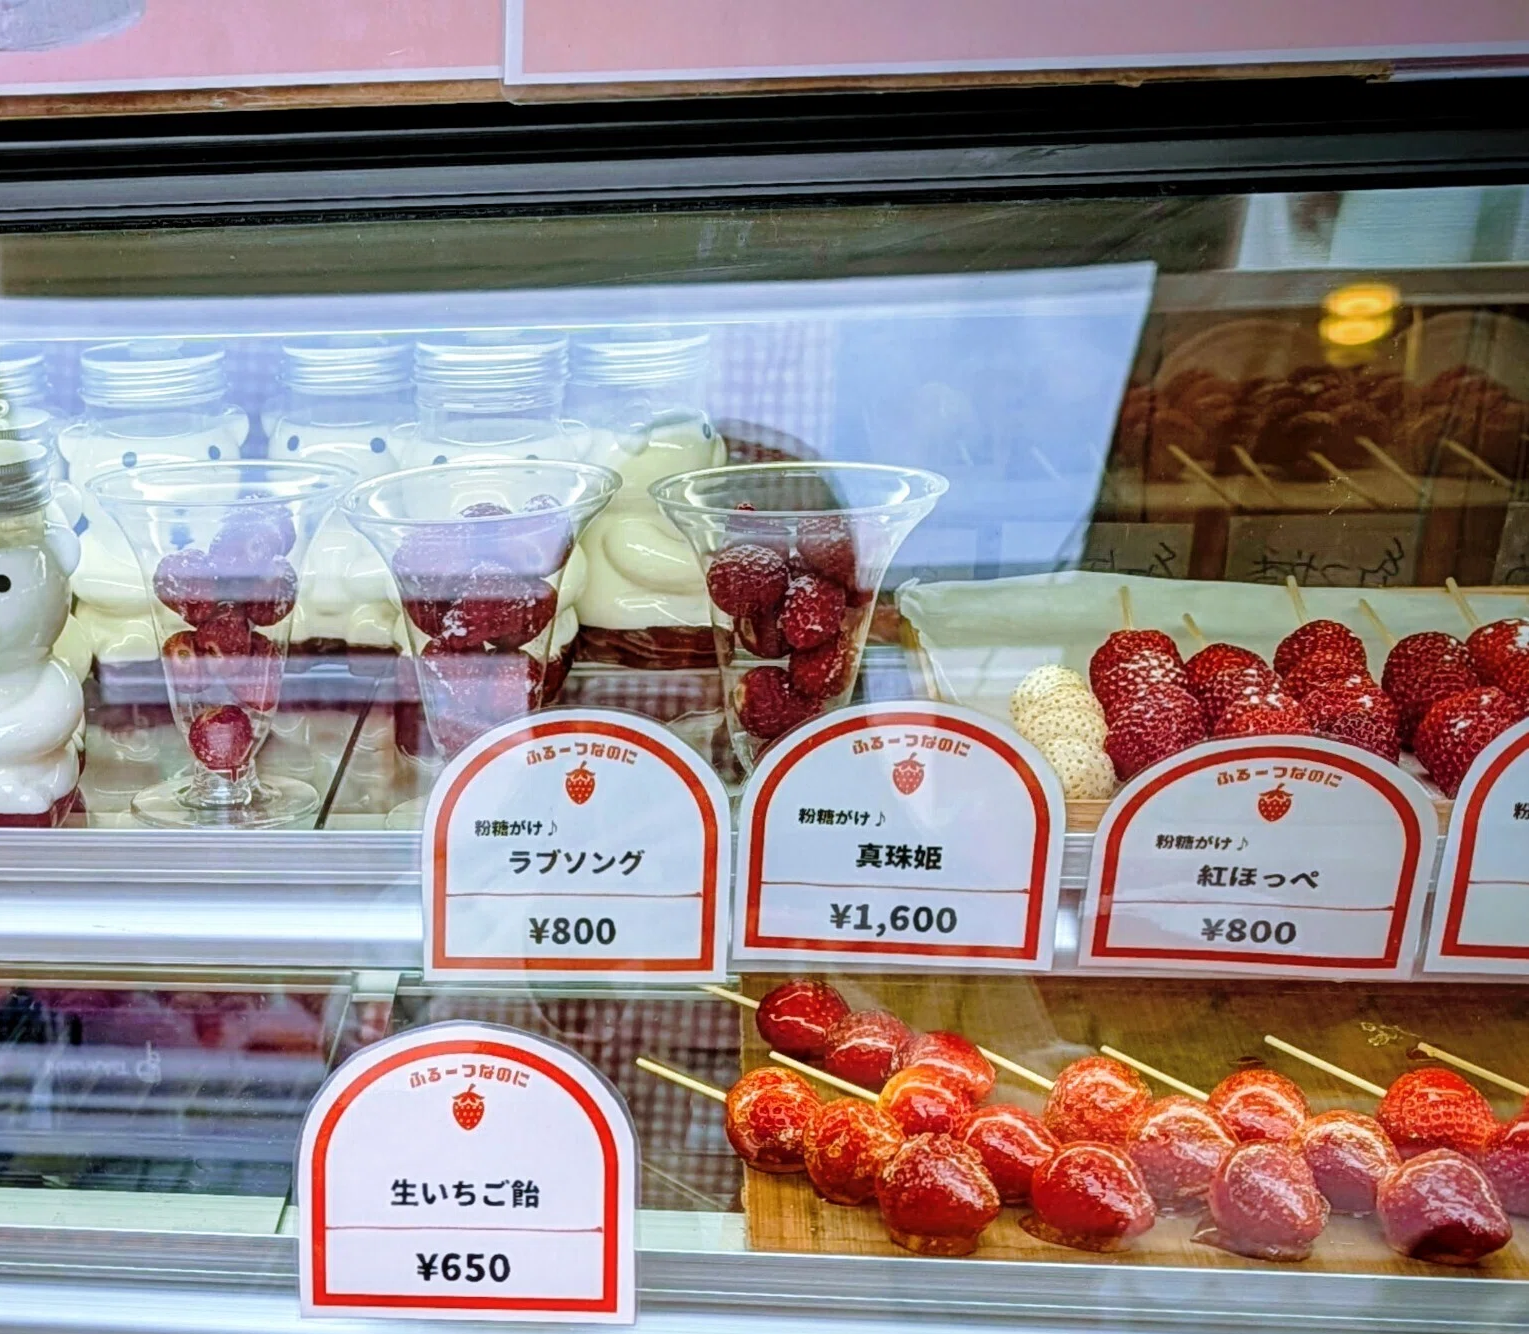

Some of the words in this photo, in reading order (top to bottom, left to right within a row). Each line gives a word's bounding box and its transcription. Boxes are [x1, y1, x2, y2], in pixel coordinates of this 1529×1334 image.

[526, 741, 638, 765] ふるーつなのに
[852, 734, 971, 757] ふるーつなのに
[1216, 766, 1343, 789] ふるーつなのに
[509, 848, 645, 876] ラブソング
[855, 842, 943, 871] 真珠姫
[1196, 864, 1320, 889] 紅ほっぺ
[528, 917, 617, 946] ¥800
[829, 903, 958, 938] ¥1,600
[1201, 918, 1297, 945] ¥800
[409, 1063, 531, 1089] ふるーつなのに
[390, 1178, 540, 1209] 生いちご飴
[416, 1252, 511, 1283] ¥650
